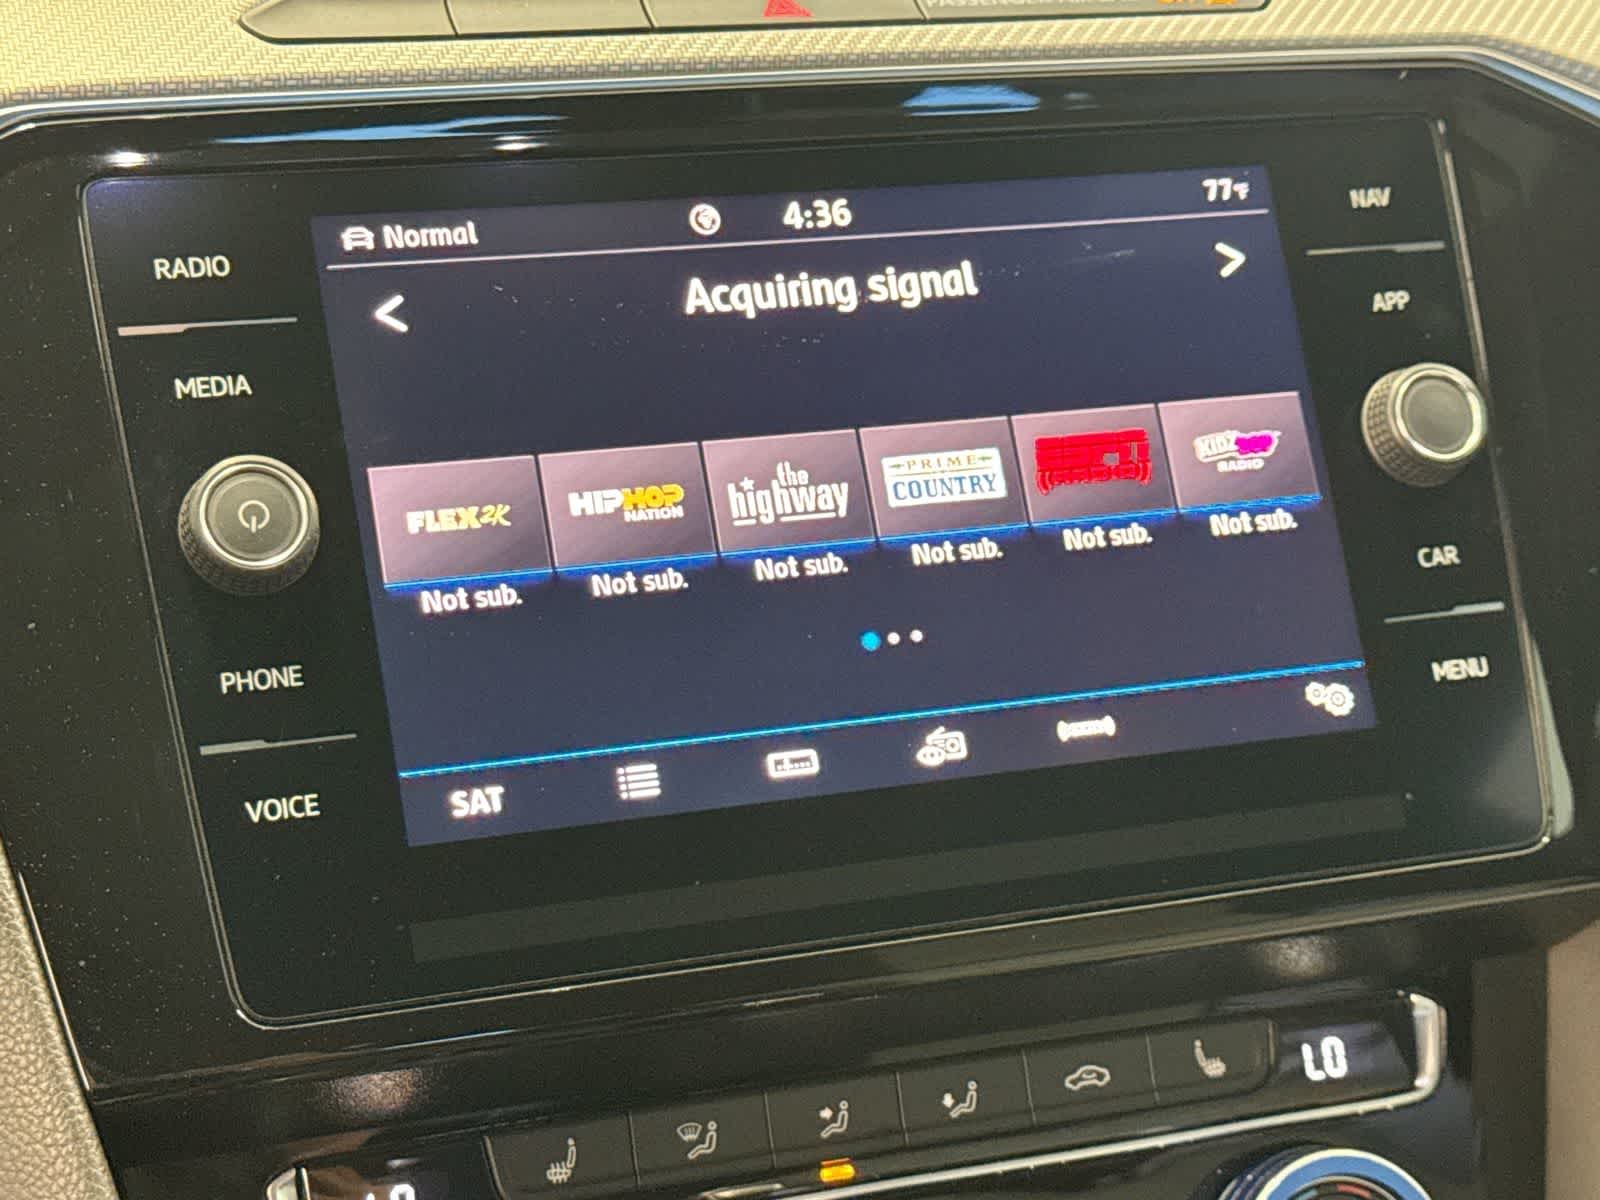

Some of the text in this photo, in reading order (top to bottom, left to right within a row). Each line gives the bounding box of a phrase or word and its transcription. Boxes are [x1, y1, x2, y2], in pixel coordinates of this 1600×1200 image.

[1349, 187, 1391, 208] NAV
[782, 198, 852, 229] 4:36
[382, 221, 479, 249] Normal
[153, 254, 231, 280] RADIO
[684, 259, 979, 319] Acquiring signal
[1371, 290, 1411, 313] APP
[174, 374, 252, 399] MEDIA
[776, 461, 809, 487] the
[906, 454, 978, 470] PRIME
[727, 478, 849, 524] highway
[892, 473, 997, 501] COUNTRY
[624, 505, 684, 522] NATION
[1210, 507, 1298, 537] Not sub.
[911, 536, 1004, 567] Not sub.
[1062, 522, 1153, 552] Not sub.
[754, 551, 849, 582] Not sub.
[1417, 544, 1460, 568] CAR
[591, 567, 689, 598] Not sub.
[420, 582, 523, 614] Not sub.
[219, 664, 304, 694] PHONE
[1431, 656, 1490, 682] MENU
[244, 793, 321, 824] VOICE
[450, 785, 505, 819] SAT
[1301, 1036, 1347, 1080] LO
